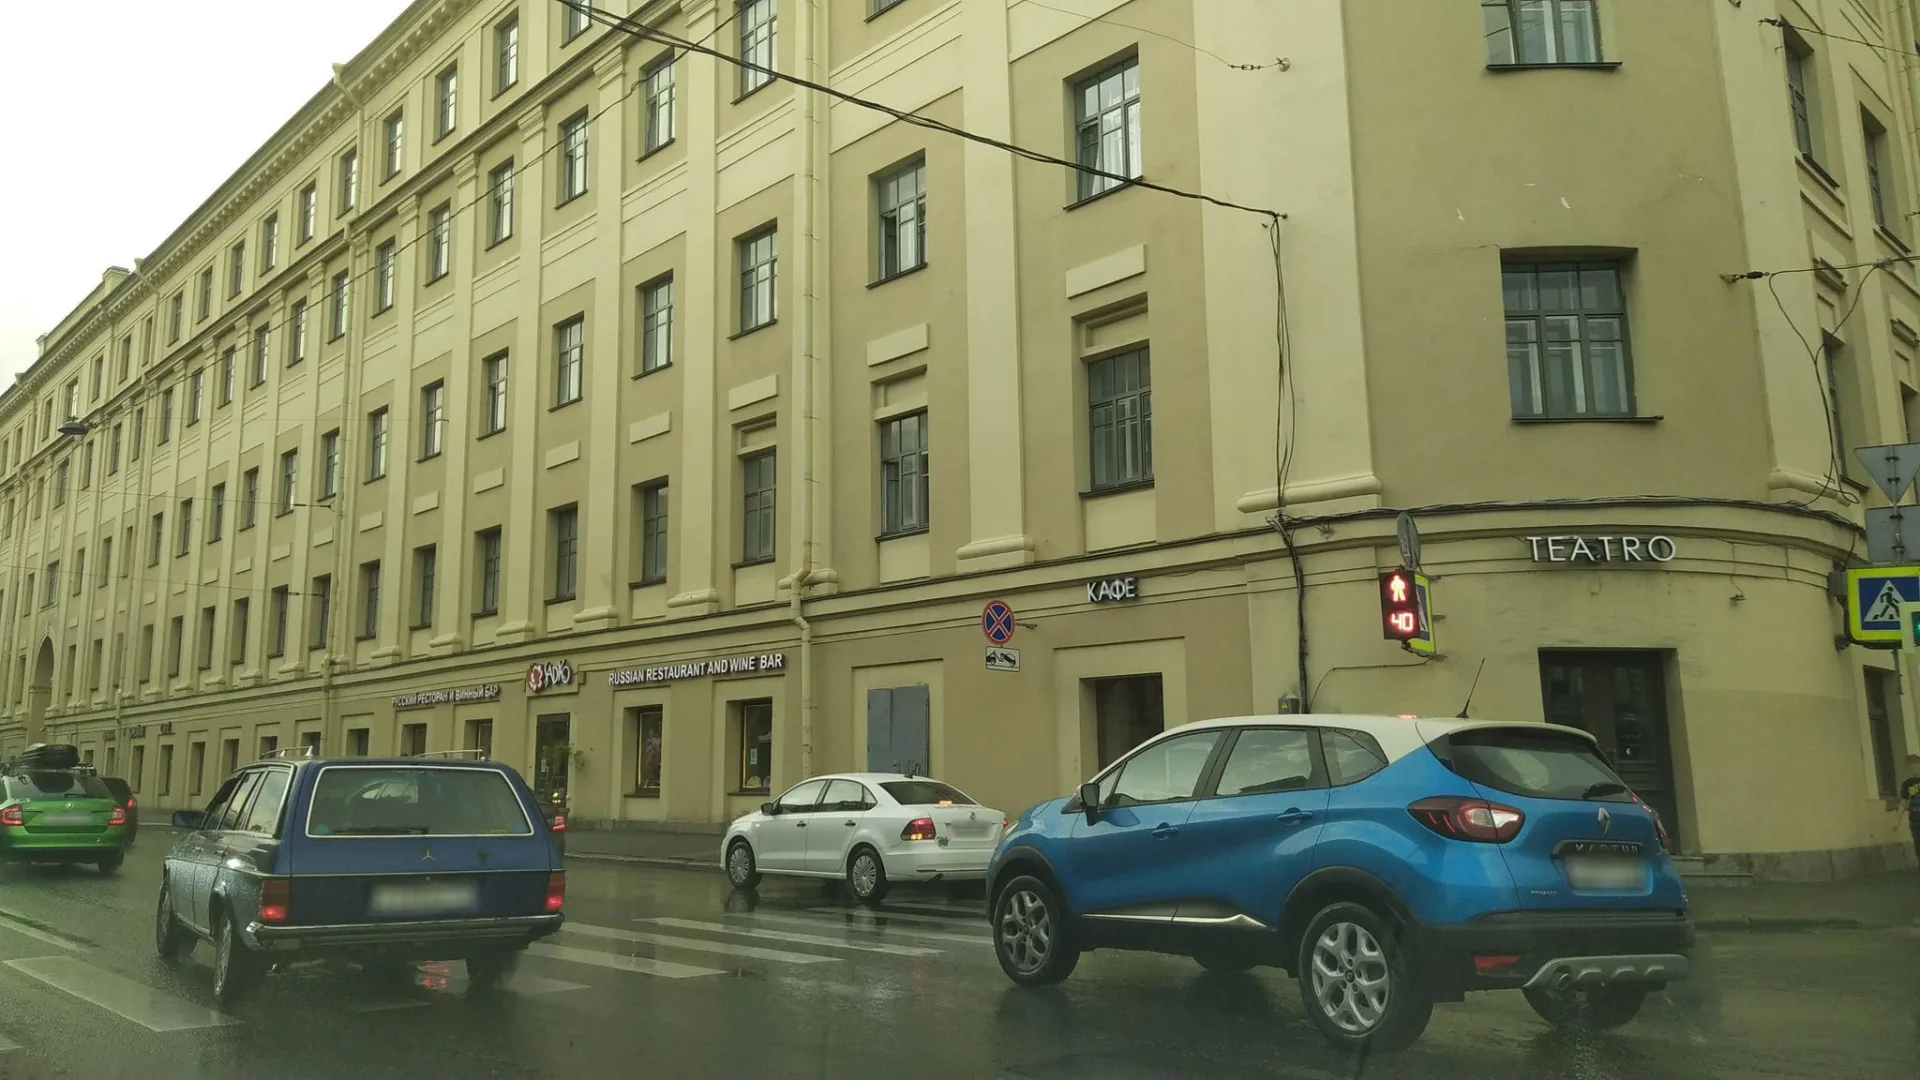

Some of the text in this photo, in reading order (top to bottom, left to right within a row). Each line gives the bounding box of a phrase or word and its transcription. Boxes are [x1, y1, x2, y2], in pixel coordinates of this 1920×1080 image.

[1526, 535, 1676, 562] TEATRO
[1087, 577, 1136, 602] КАФЕ
[1391, 612, 1414, 631] 40
[609, 653, 783, 685] RUSSIAN RESTAURANT AND WINE BAR
[392, 685, 498, 707] РУССКИЙ РЕСТОРАН И ВИННЫЙ БАР
